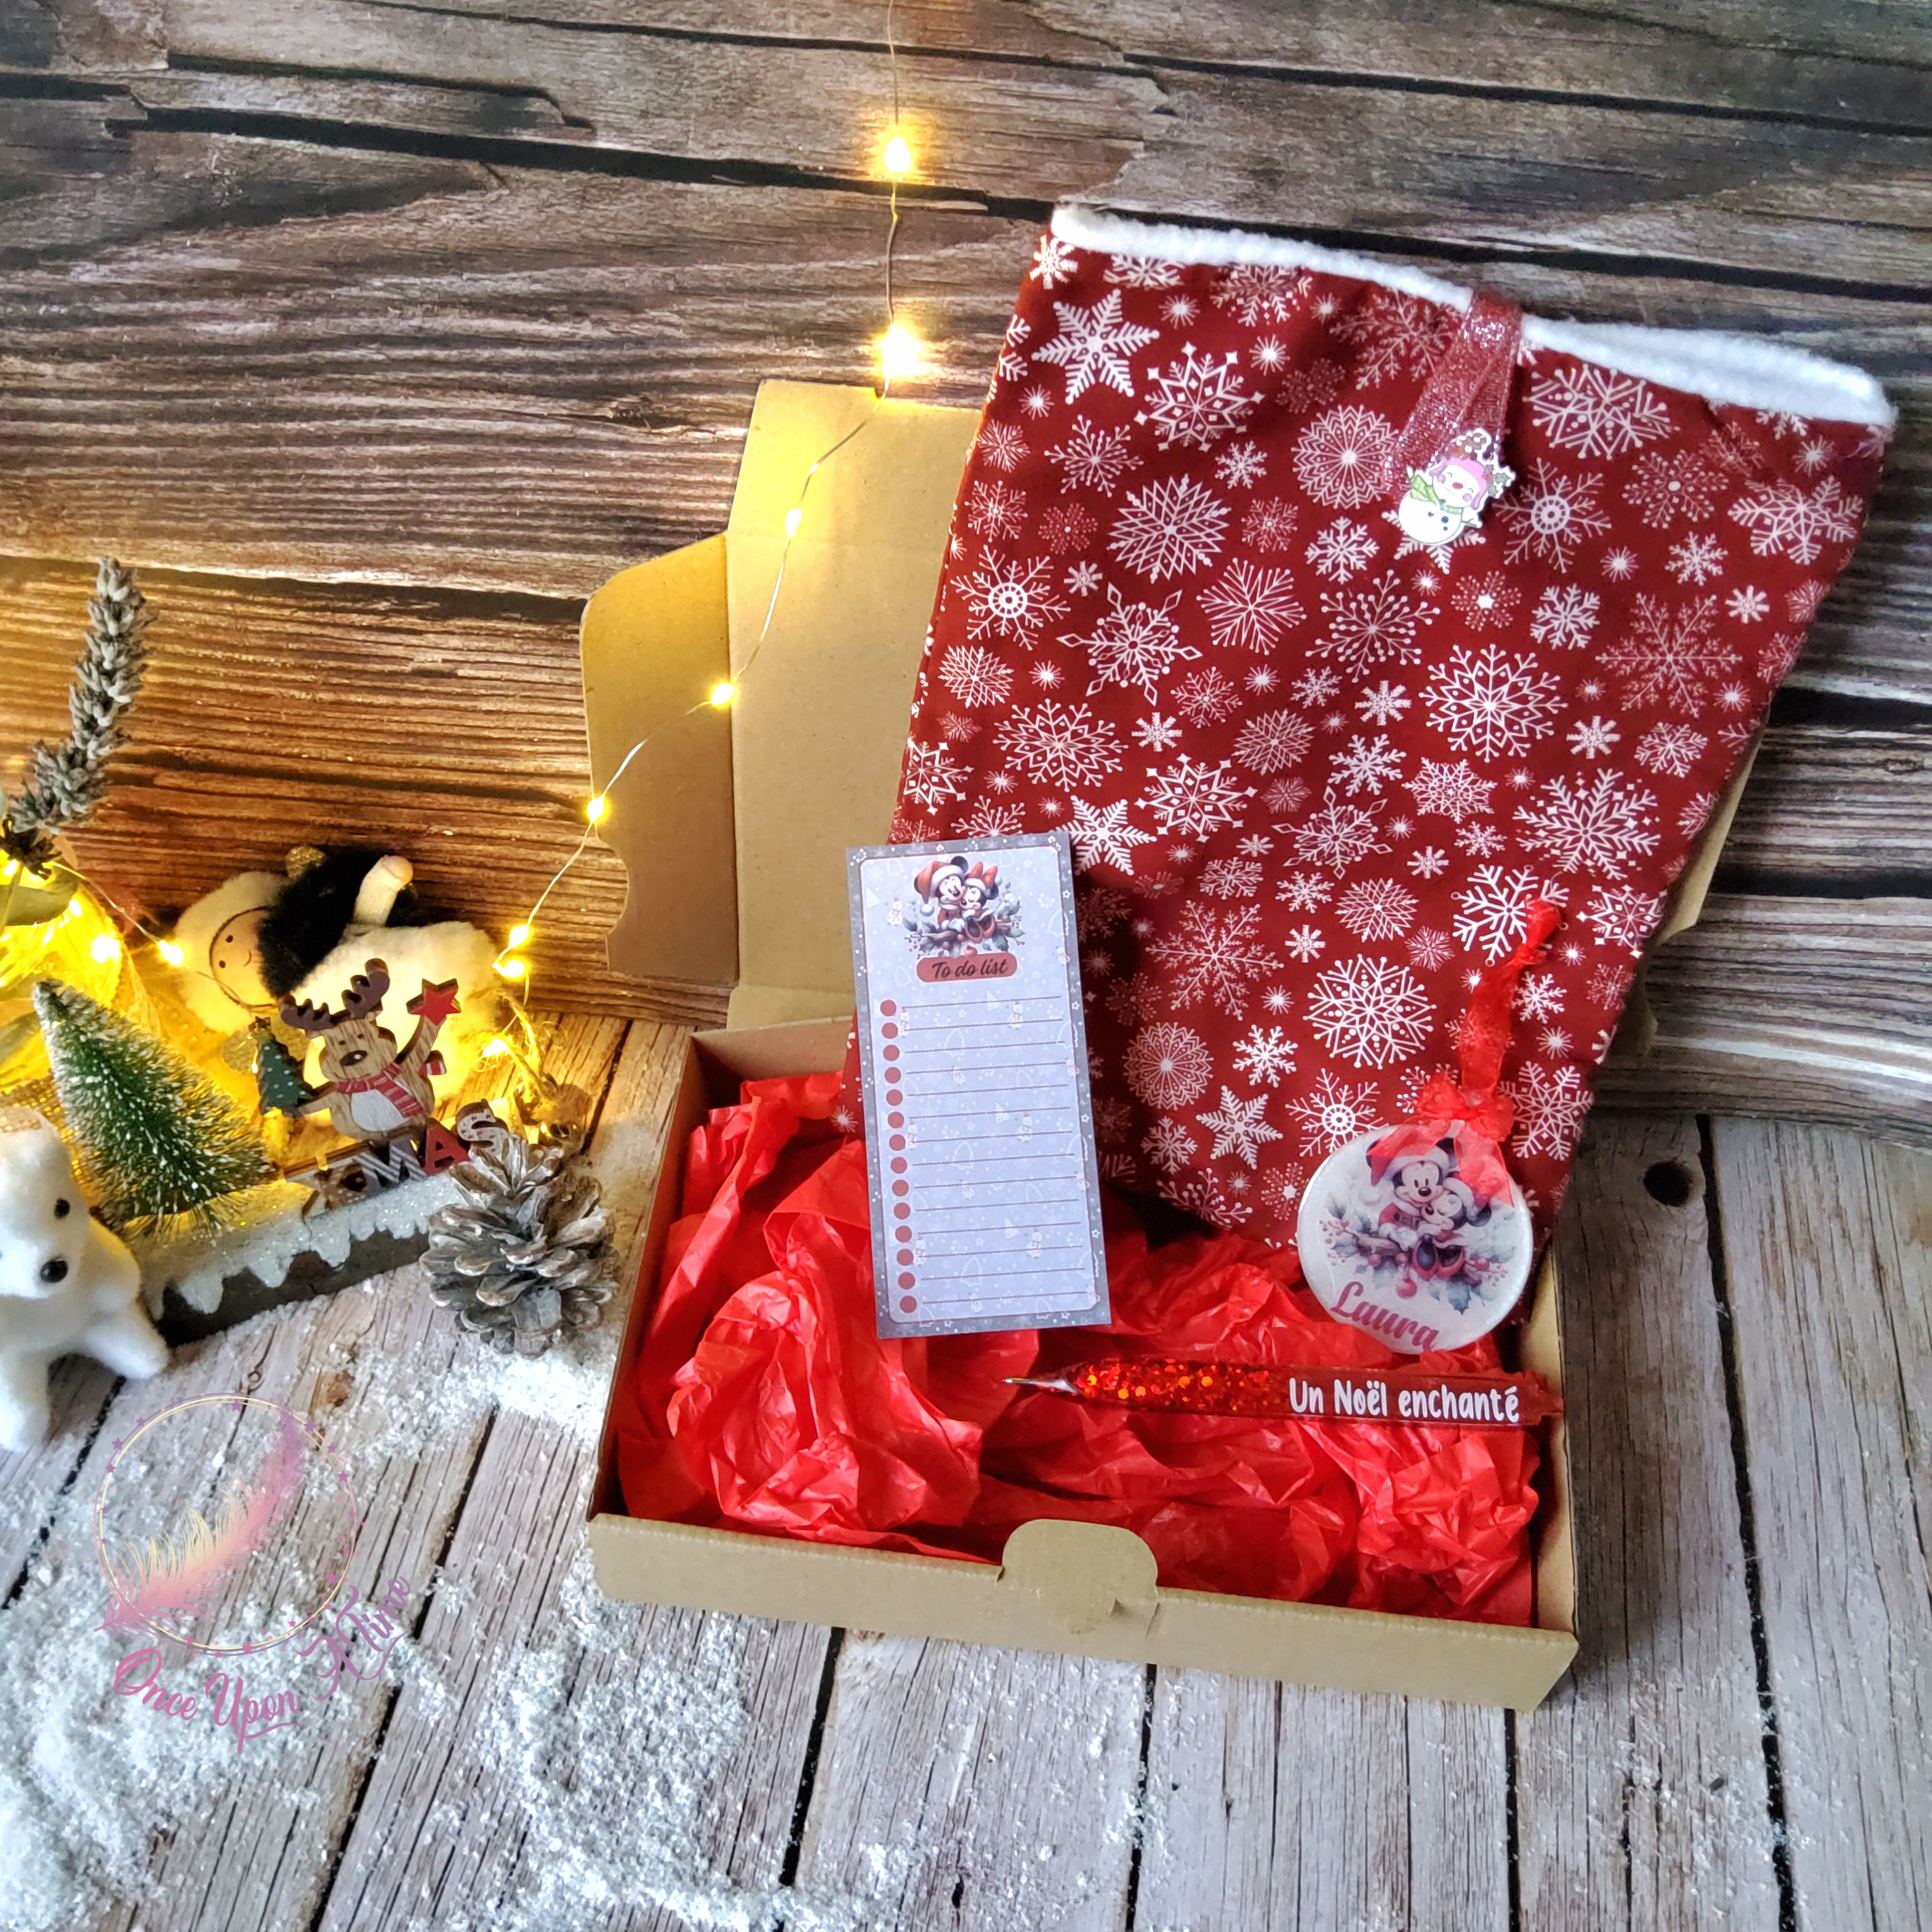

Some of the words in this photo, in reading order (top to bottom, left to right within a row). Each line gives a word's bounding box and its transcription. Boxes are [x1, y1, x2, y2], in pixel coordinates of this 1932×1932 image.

[932, 962, 953, 979] To
[955, 960, 977, 977] do
[981, 958, 1008, 975] list
[1330, 1281, 1440, 1350] Laura
[1289, 1378, 1324, 1414] Un
[1334, 1379, 1388, 1417] Noël
[1398, 1384, 1520, 1423] enchanté
